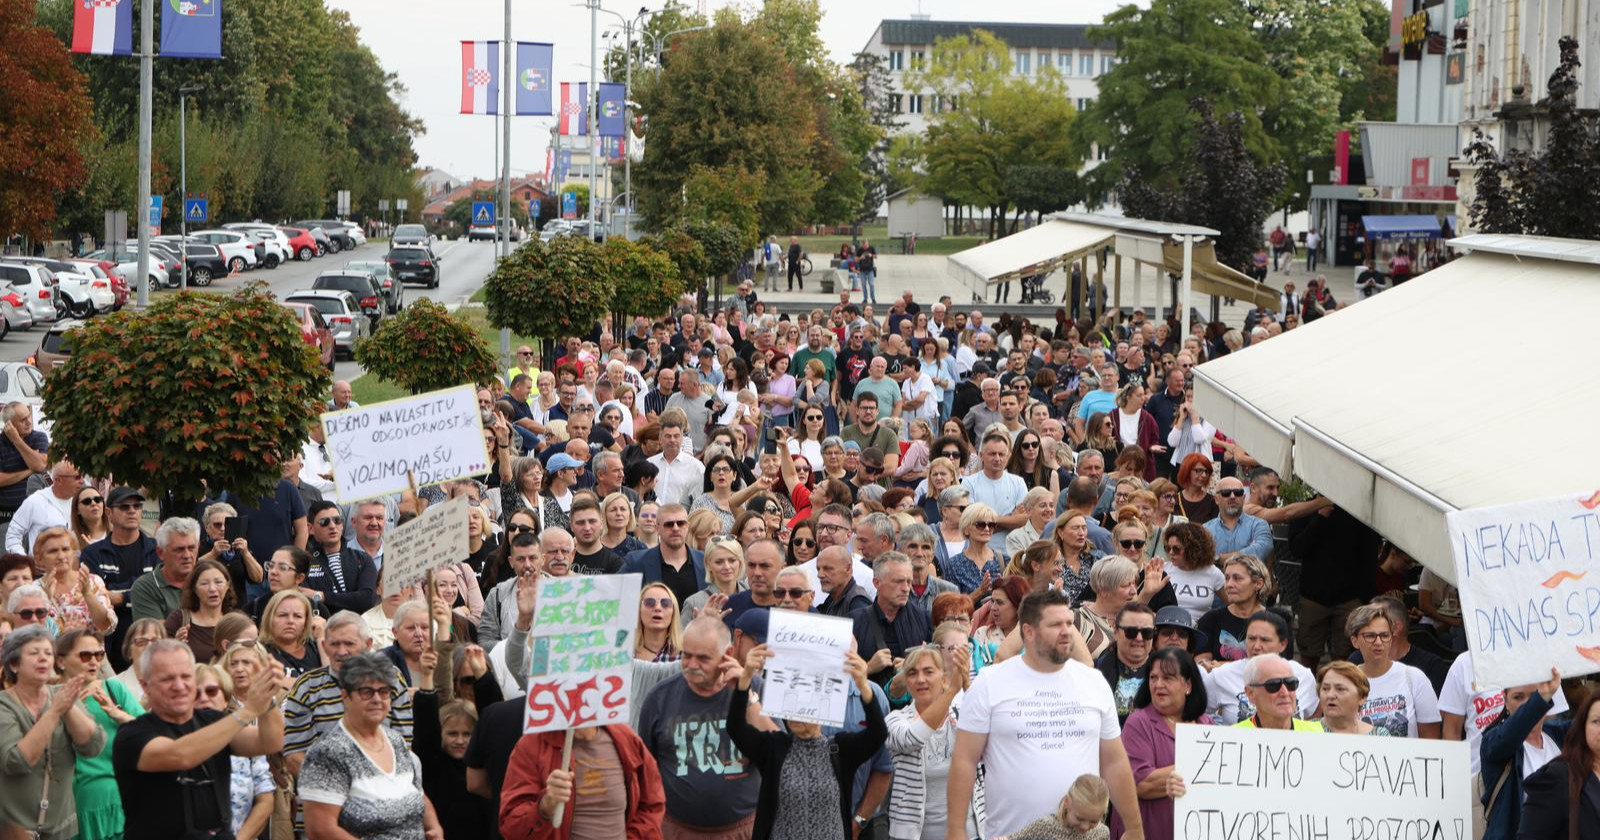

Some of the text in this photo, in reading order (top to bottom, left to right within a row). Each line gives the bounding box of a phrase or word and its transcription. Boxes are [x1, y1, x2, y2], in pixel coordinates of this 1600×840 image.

[326, 412, 369, 437] DIŠEMO
[372, 415, 460, 443] ODGOVORNOST
[412, 445, 452, 471] NAŠU
[418, 465, 462, 487] DJECU
[1463, 520, 1565, 577] NEKADA
[1475, 597, 1558, 652] DANAS
[525, 675, 627, 729] SVE?
[1024, 709, 1048, 717] svojih
[1017, 729, 1086, 740] posudili od svoje
[1068, 719, 1076, 727] je
[1192, 731, 1445, 799] ŽELIMO SPAVATI
